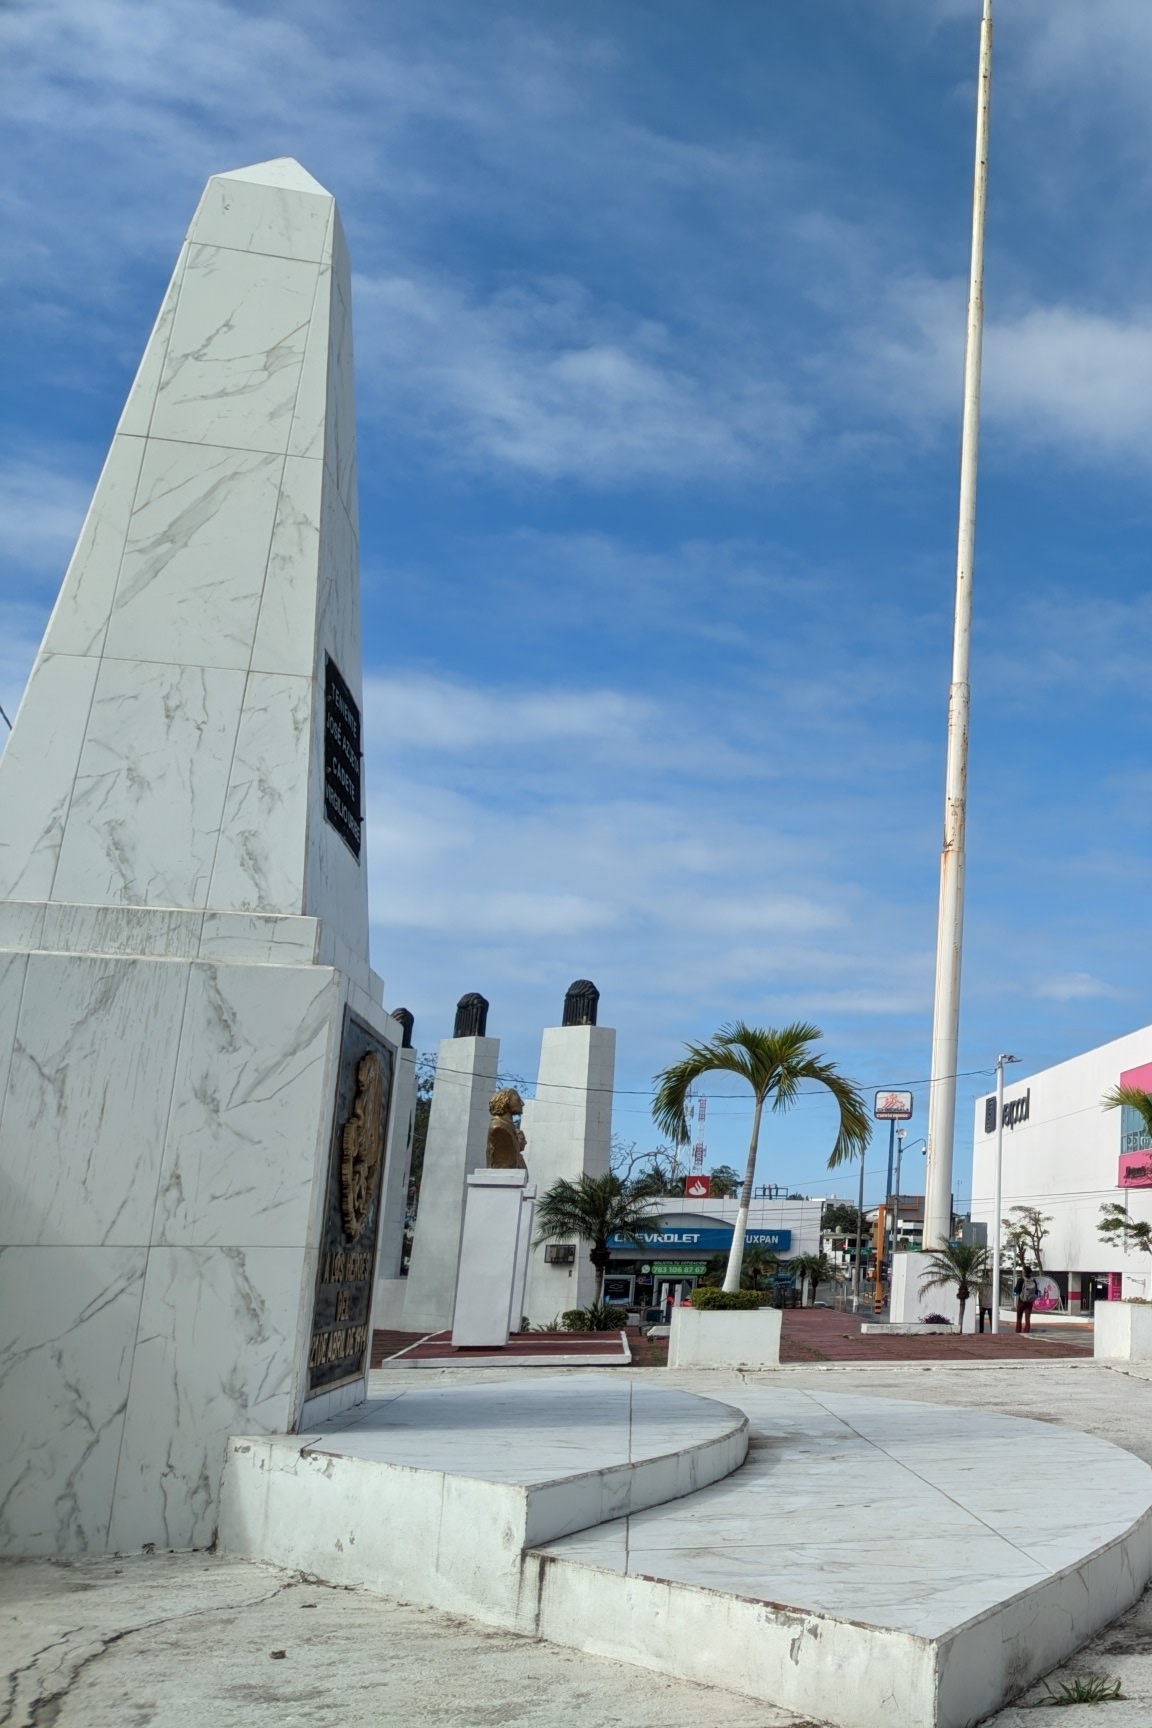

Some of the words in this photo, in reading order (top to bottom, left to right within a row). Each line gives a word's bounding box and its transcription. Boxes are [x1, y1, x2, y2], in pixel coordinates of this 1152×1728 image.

[331, 682, 357, 739] TENIENTE
[326, 712, 342, 747] JOSÉ
[332, 756, 355, 802] CADETE
[323, 1252, 330, 1284] A
[331, 1251, 345, 1283] LOS
[346, 1252, 370, 1282] HEROES
[328, 1328, 345, 1363] ABRIL
